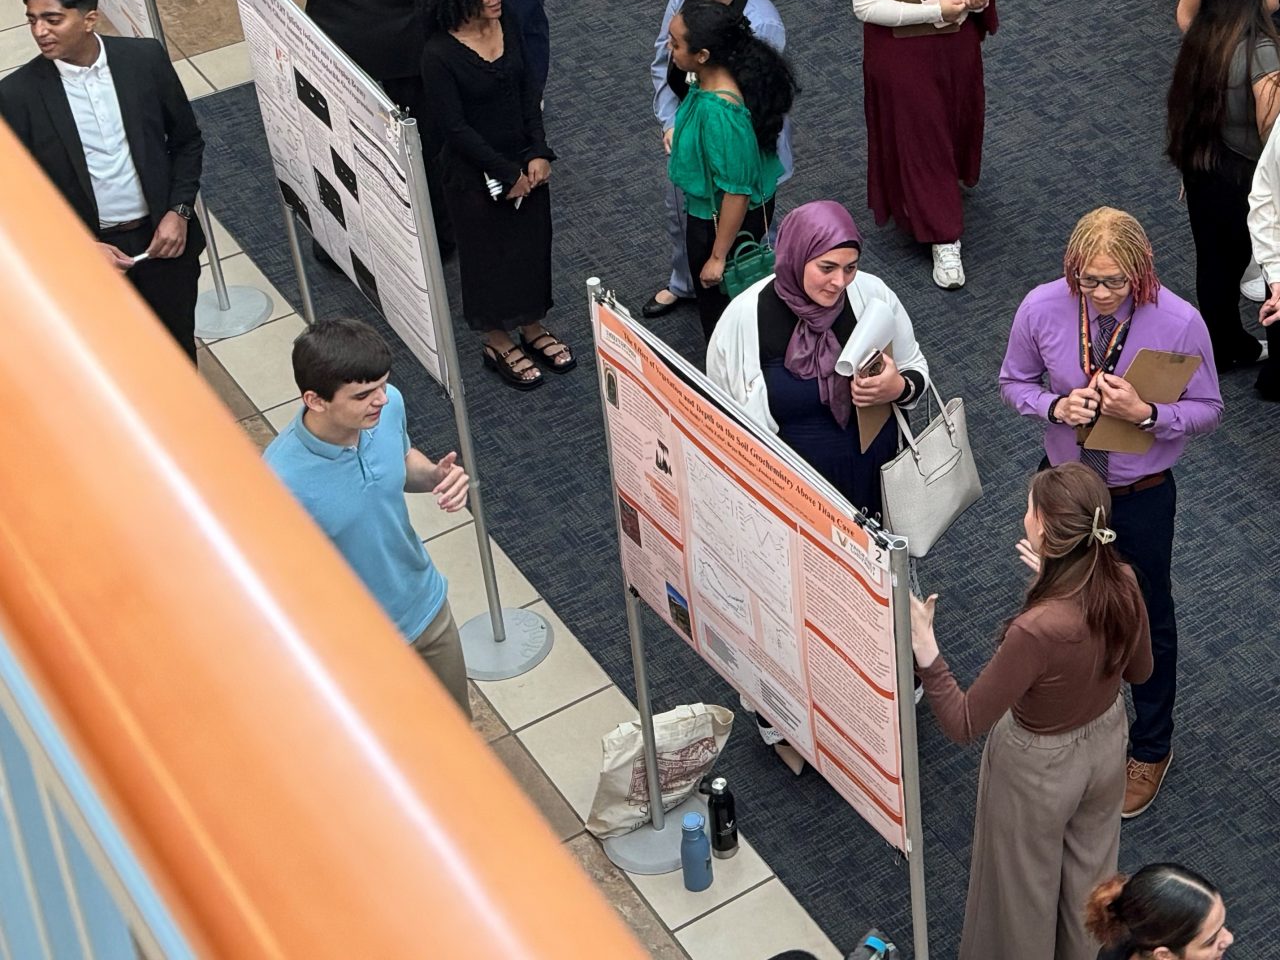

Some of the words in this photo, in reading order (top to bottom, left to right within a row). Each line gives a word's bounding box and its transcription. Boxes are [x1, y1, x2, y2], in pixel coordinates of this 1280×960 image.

[622, 330, 632, 344] The
[634, 344, 649, 362] Effect
[650, 360, 655, 368] of
[655, 365, 682, 398] Vegetation
[684, 394, 694, 408] and
[696, 402, 714, 424] Depth
[716, 421, 724, 432] on
[725, 426, 735, 441] the
[736, 436, 749, 451] Soil
[750, 446, 794, 490] Geochemistry
[796, 484, 817, 508] Above
[818, 500, 836, 523] Titan
[836, 514, 855, 537] Cave
[875, 549, 882, 564] 2
